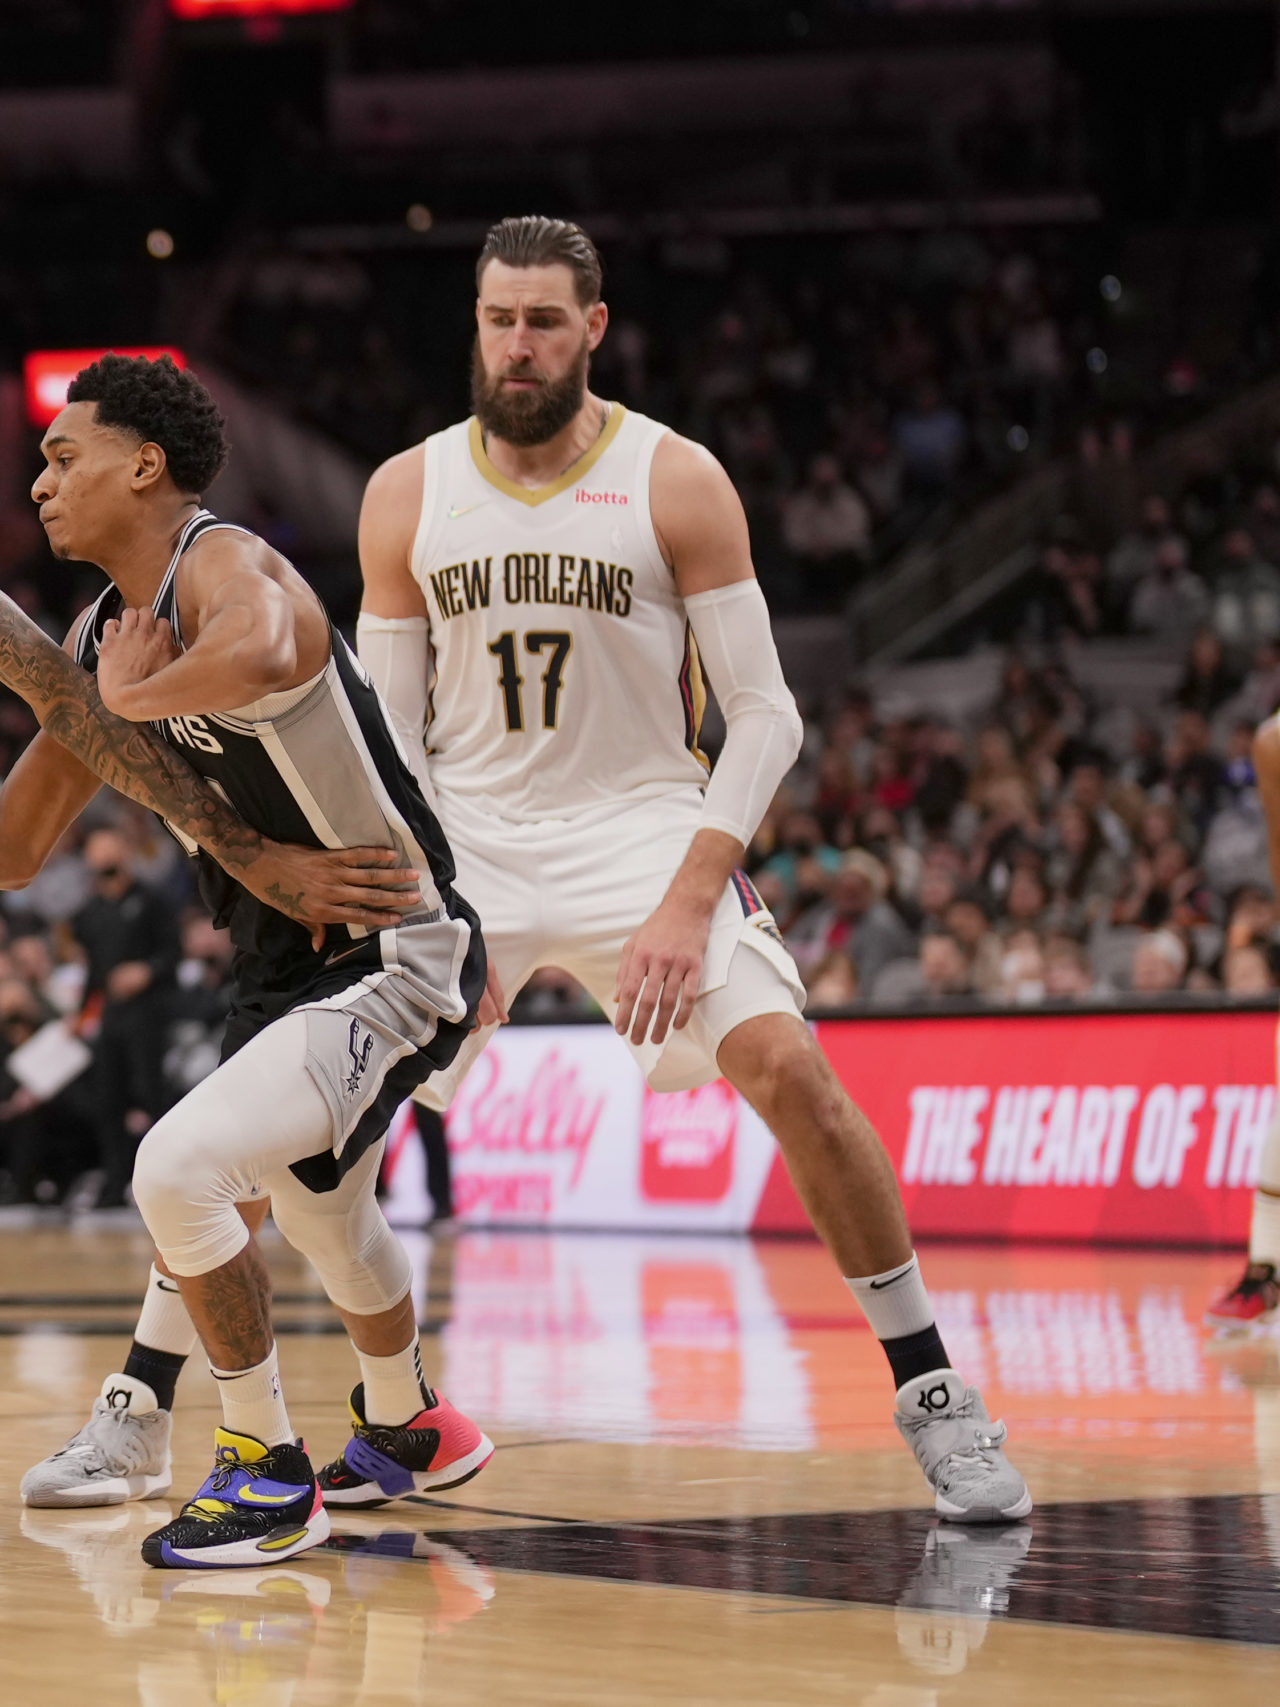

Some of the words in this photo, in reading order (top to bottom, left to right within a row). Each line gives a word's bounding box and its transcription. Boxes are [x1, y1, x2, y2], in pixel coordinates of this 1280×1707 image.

[575, 489, 628, 505] ibotta
[429, 557, 492, 621] NEW
[503, 553, 633, 618] ORLEANS
[487, 631, 573, 732] 17
[902, 1085, 990, 1186] THE
[982, 1085, 1139, 1188] HEART
[1132, 1083, 1206, 1189] OF
